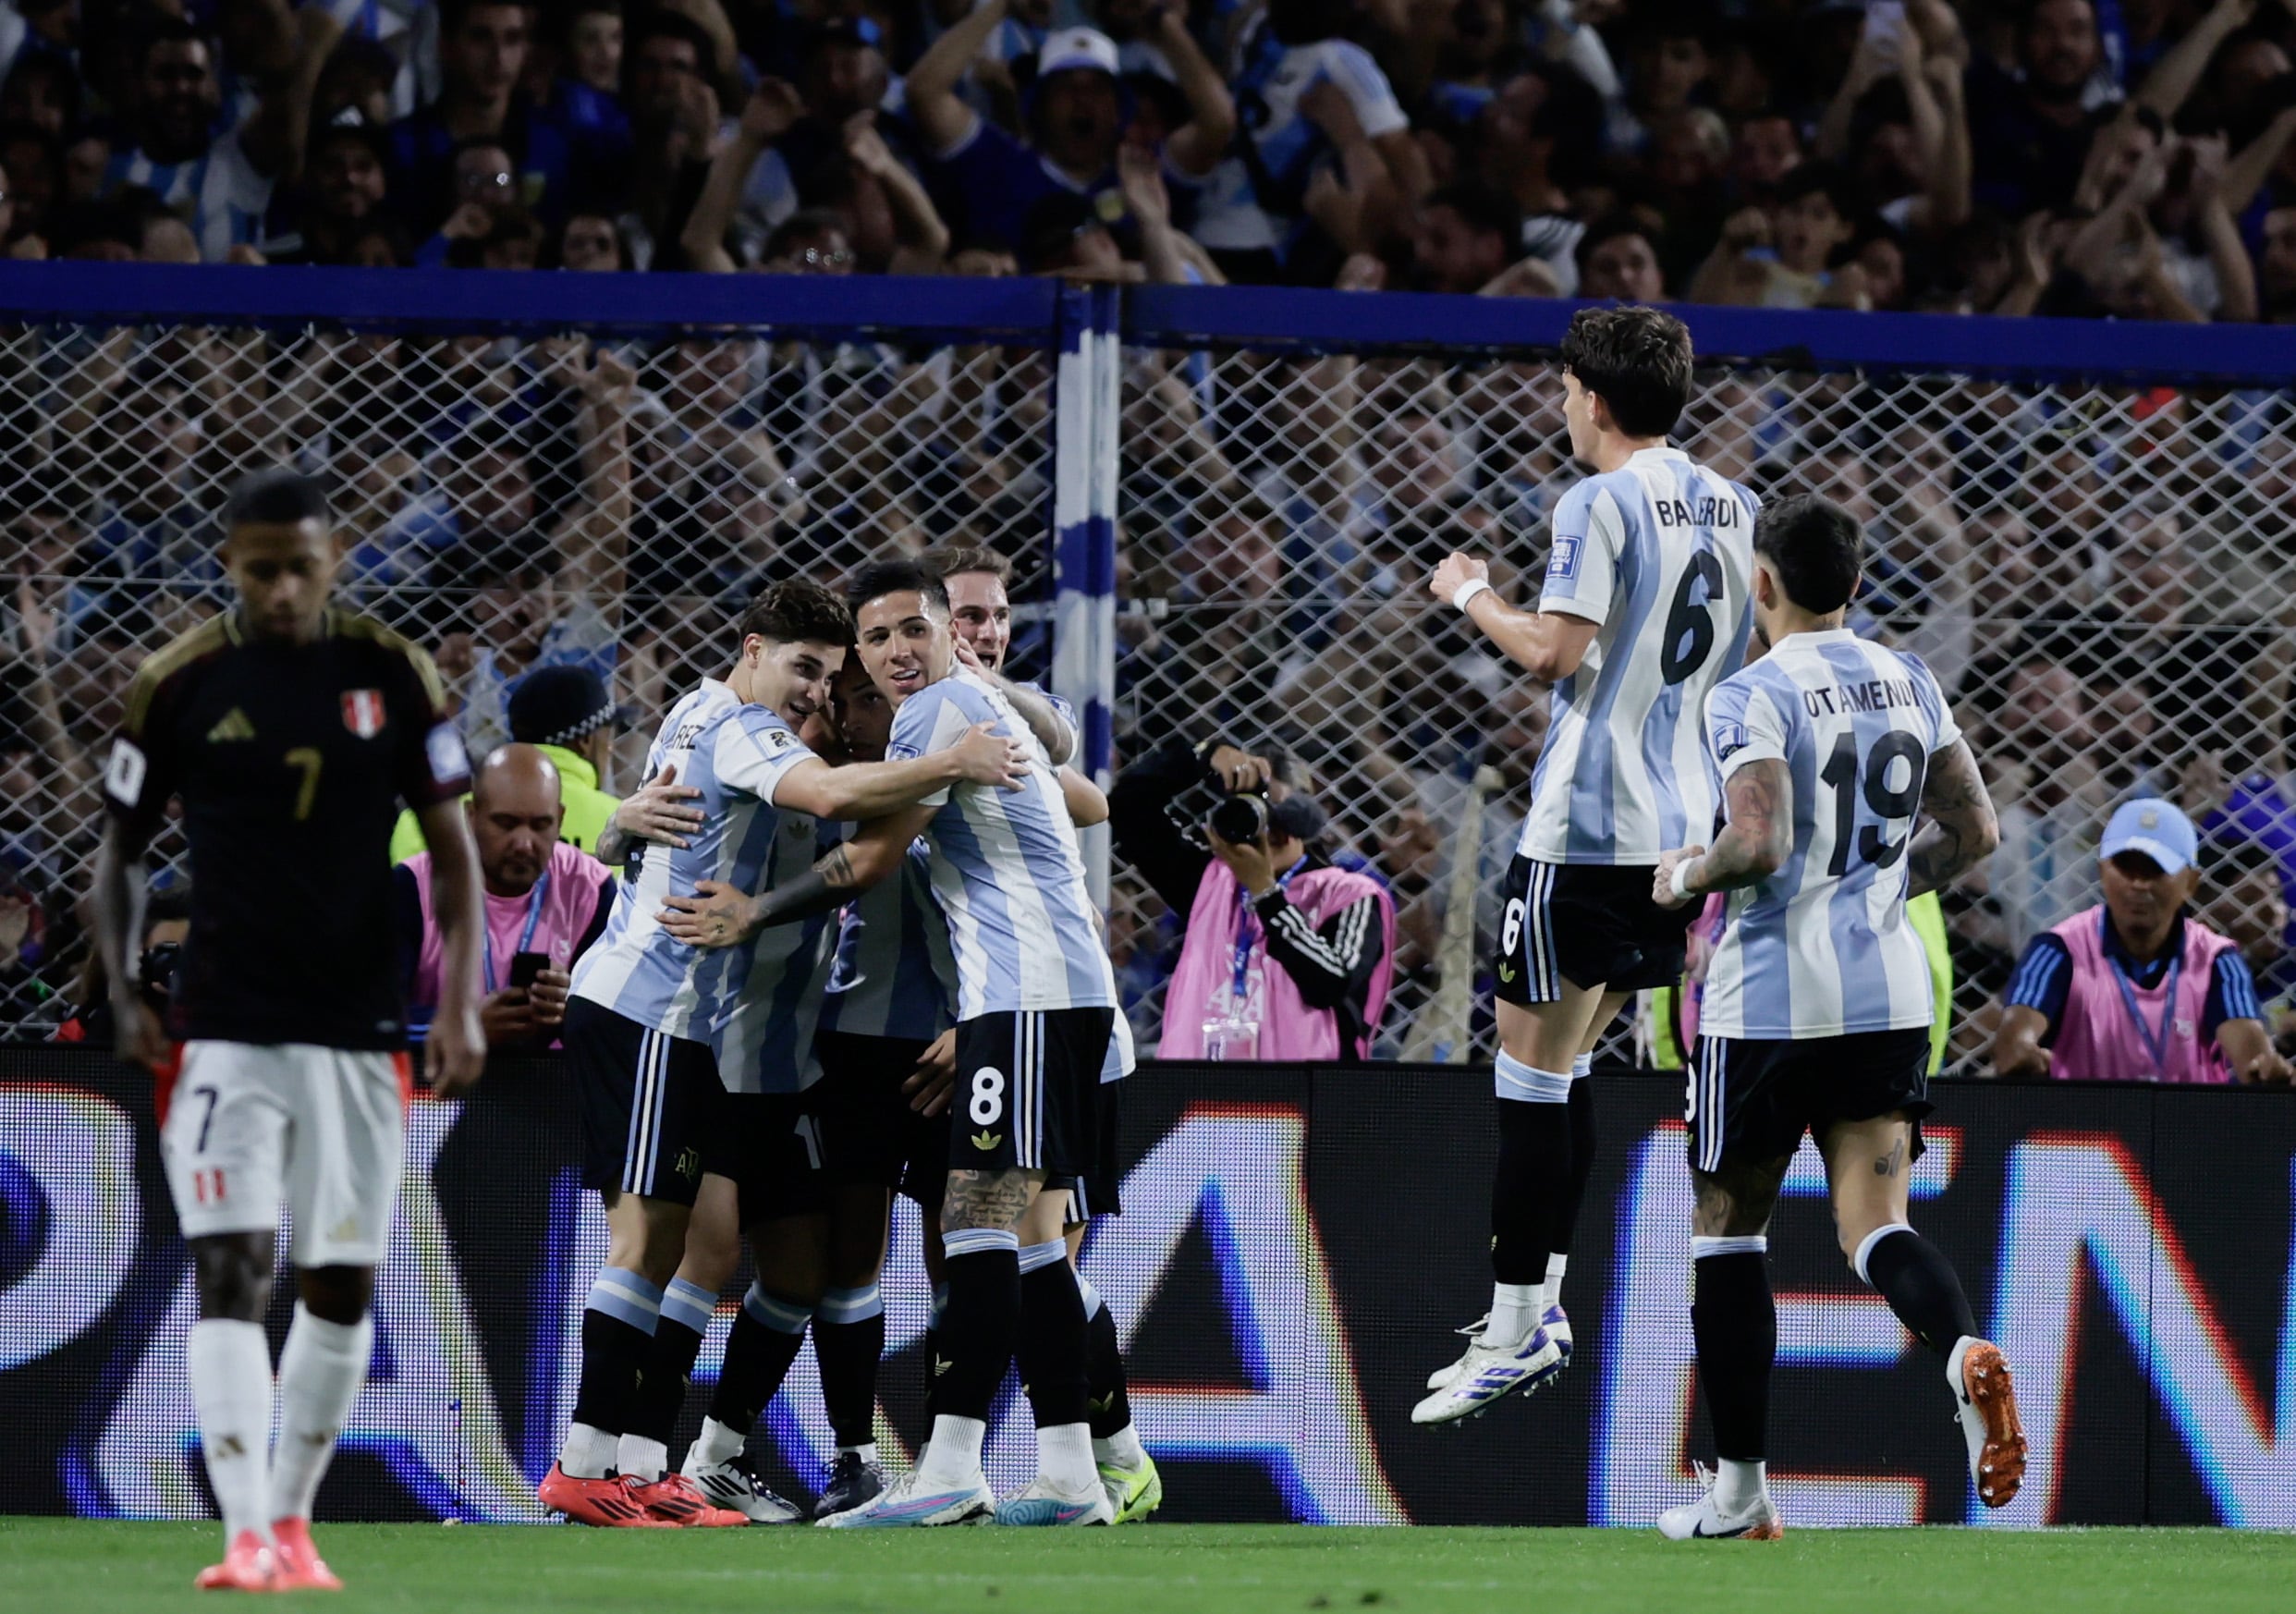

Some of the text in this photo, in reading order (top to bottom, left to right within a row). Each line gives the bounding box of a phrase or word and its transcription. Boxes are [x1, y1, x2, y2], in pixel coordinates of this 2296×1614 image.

[1660, 549, 1724, 686] 6
[1803, 679, 1922, 718] OTAMENDI
[285, 746, 324, 822] 7
[1820, 729, 1925, 877] 19
[1502, 897, 1526, 957] 6
[193, 1084, 218, 1154] 7
[969, 1066, 1006, 1125] 8
